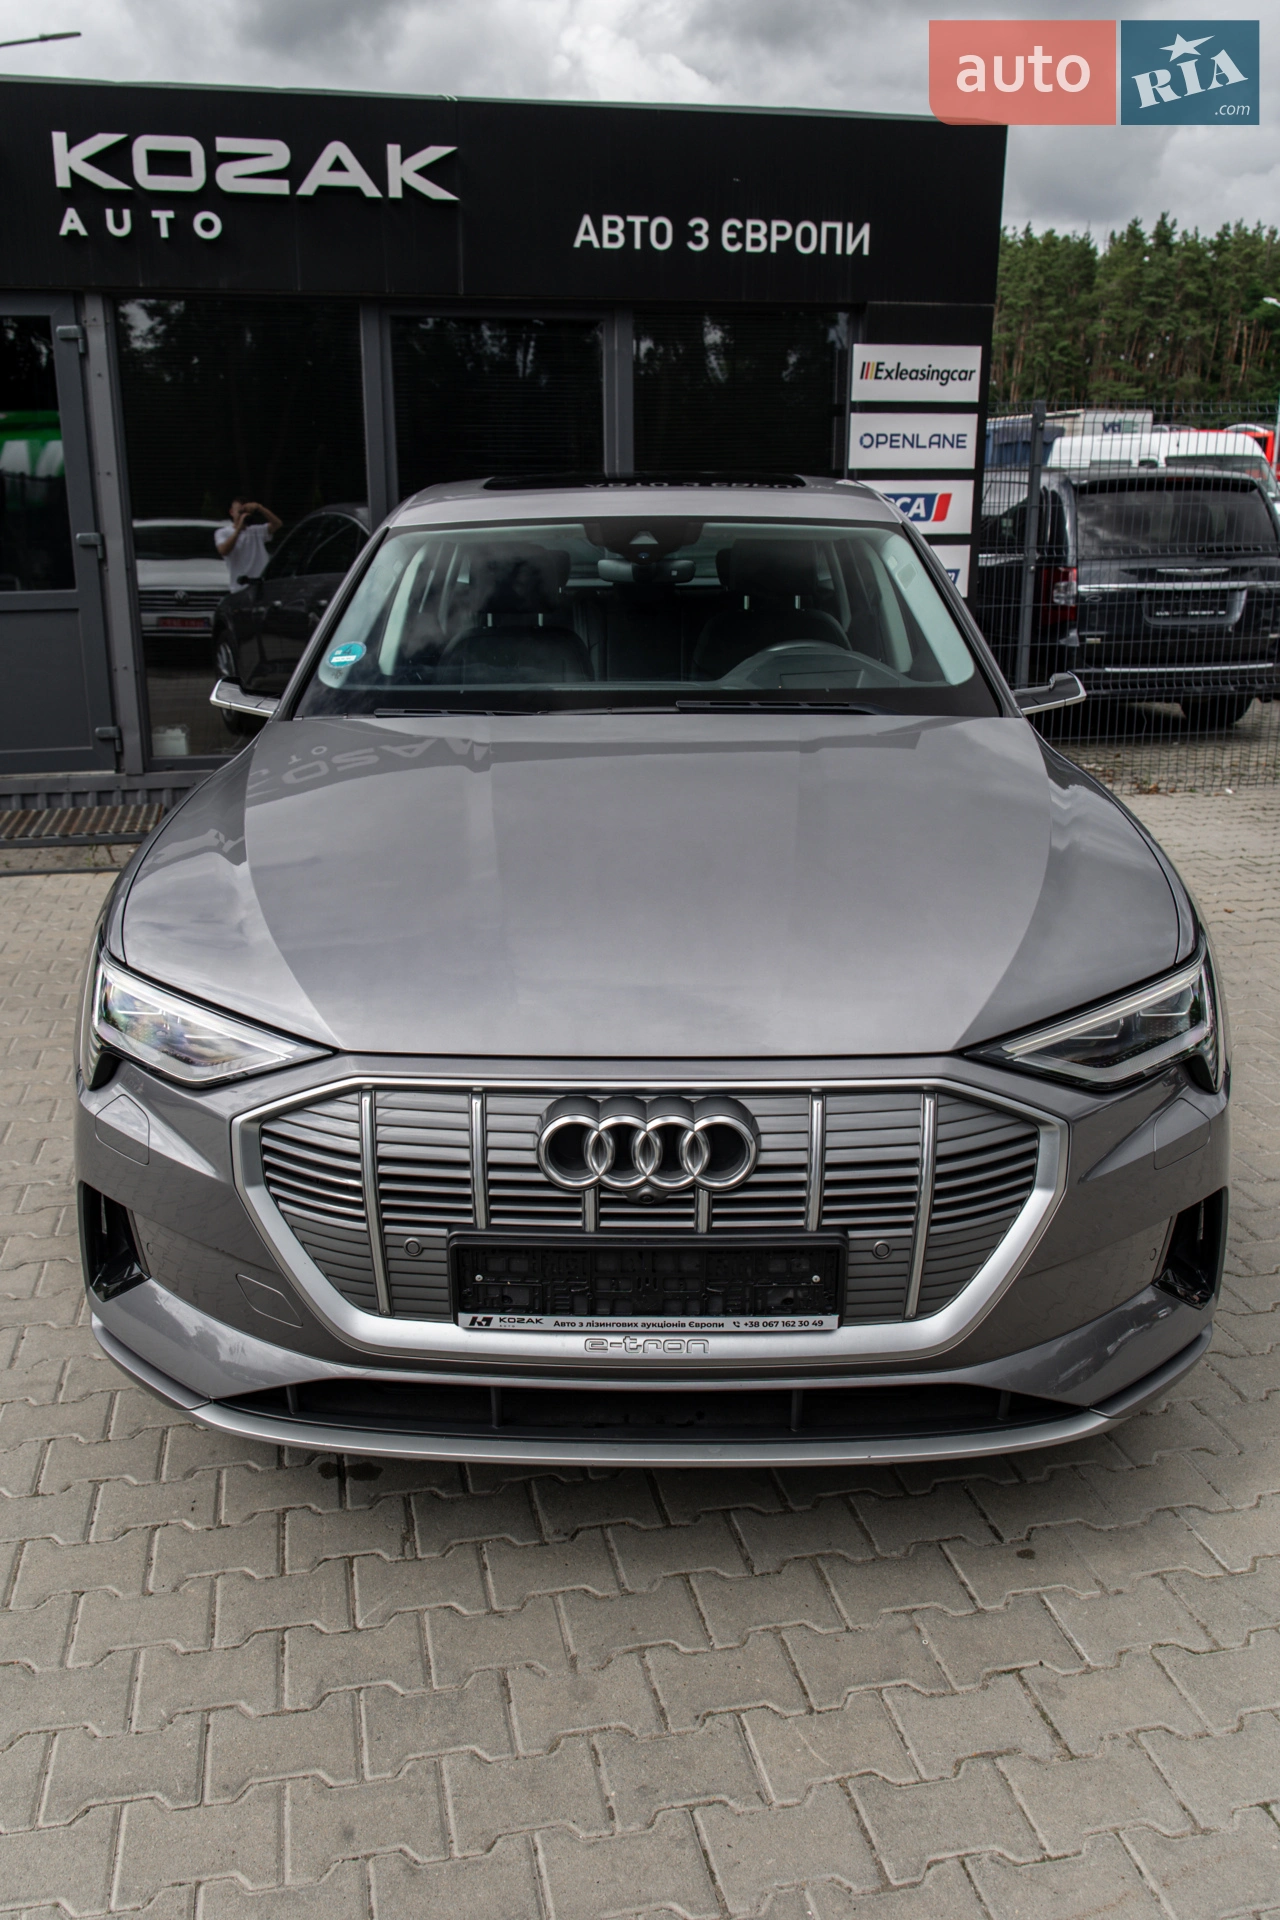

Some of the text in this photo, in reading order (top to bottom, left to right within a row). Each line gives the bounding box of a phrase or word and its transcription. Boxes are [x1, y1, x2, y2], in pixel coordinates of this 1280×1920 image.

[52, 131, 459, 201] KOZAK
[59, 208, 222, 240] AUTO
[573, 214, 871, 255] АВТО З ЄВРОПИ
[874, 361, 976, 386] Exleasingcar
[859, 433, 968, 449] OPENLANE
[890, 497, 926, 518] CA
[499, 1317, 544, 1325] KOZAK
[586, 1320, 638, 1328] лізингових
[641, 1321, 686, 1329] аукціонів
[688, 1321, 724, 1329] Європи
[584, 1336, 710, 1354] e-tron
